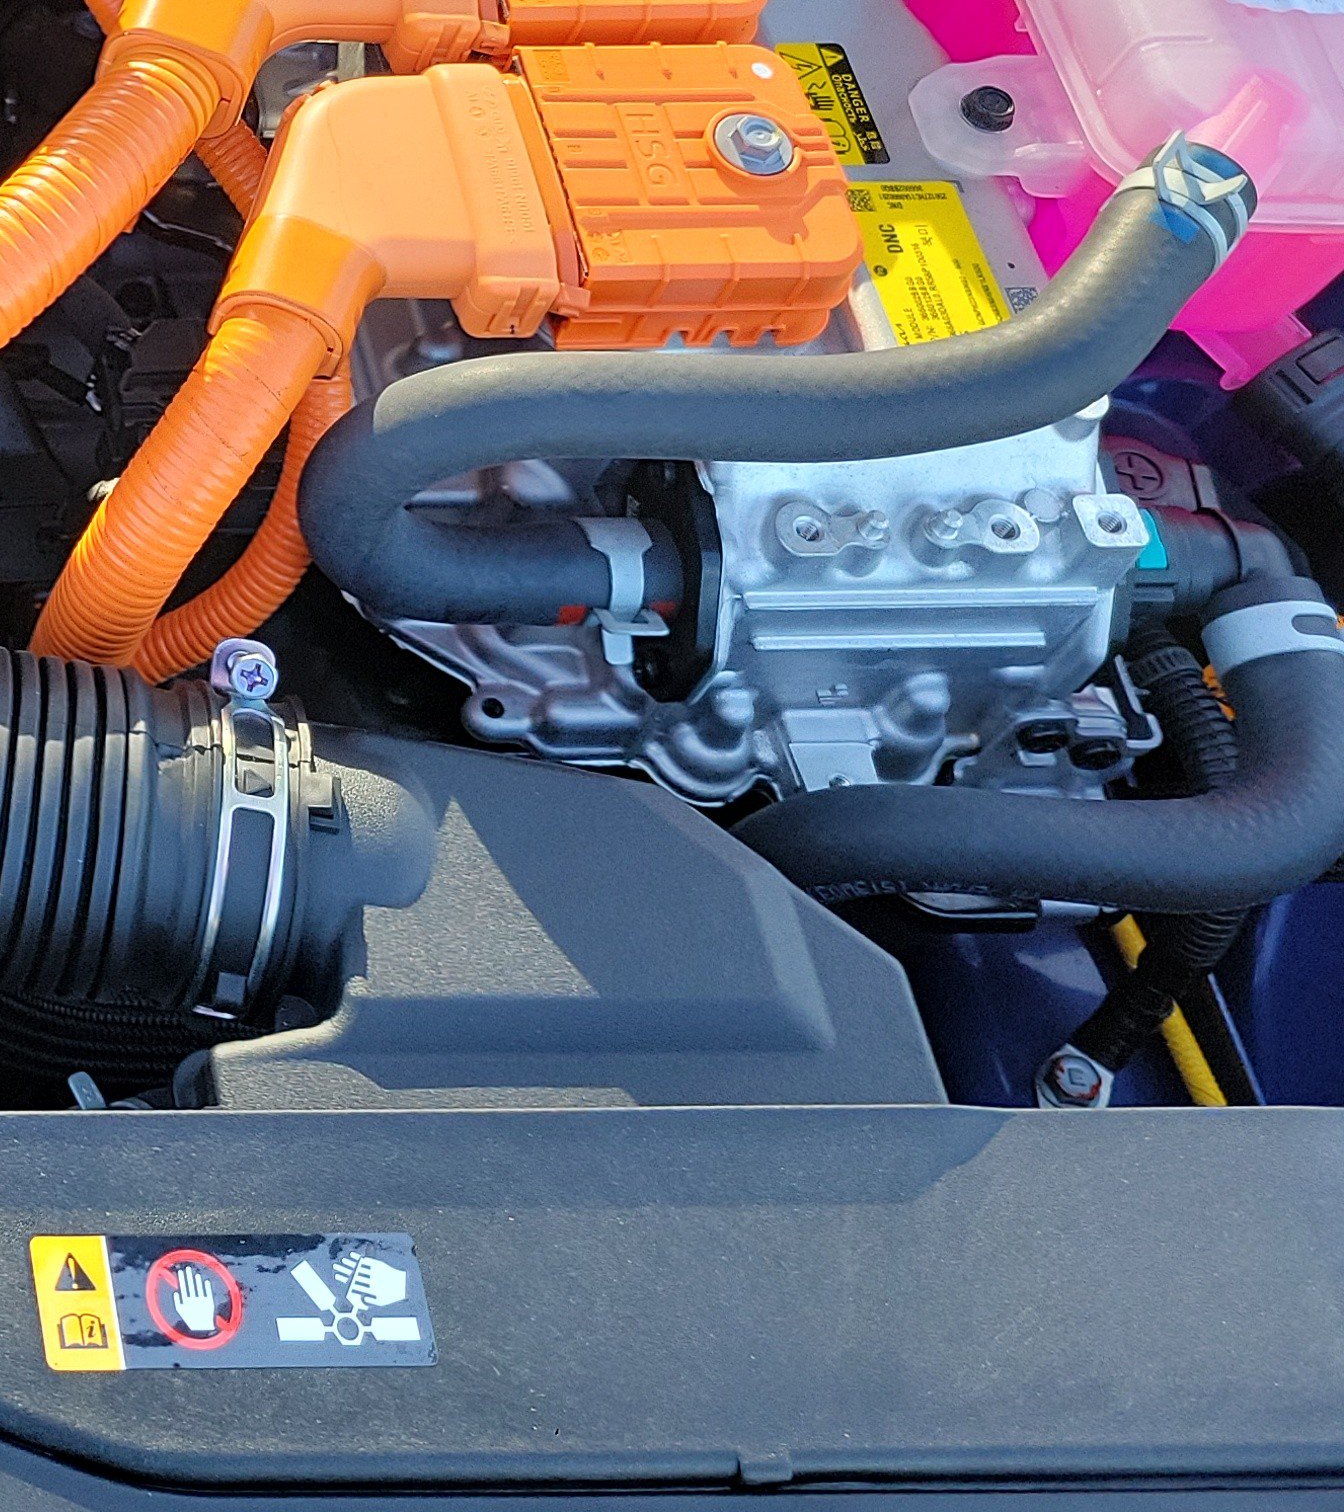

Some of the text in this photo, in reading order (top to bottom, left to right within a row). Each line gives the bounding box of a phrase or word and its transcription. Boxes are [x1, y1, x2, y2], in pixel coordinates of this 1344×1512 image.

[841, 73, 870, 123] DANGER
[625, 113, 678, 185] HSG
[878, 223, 904, 254] DNC
